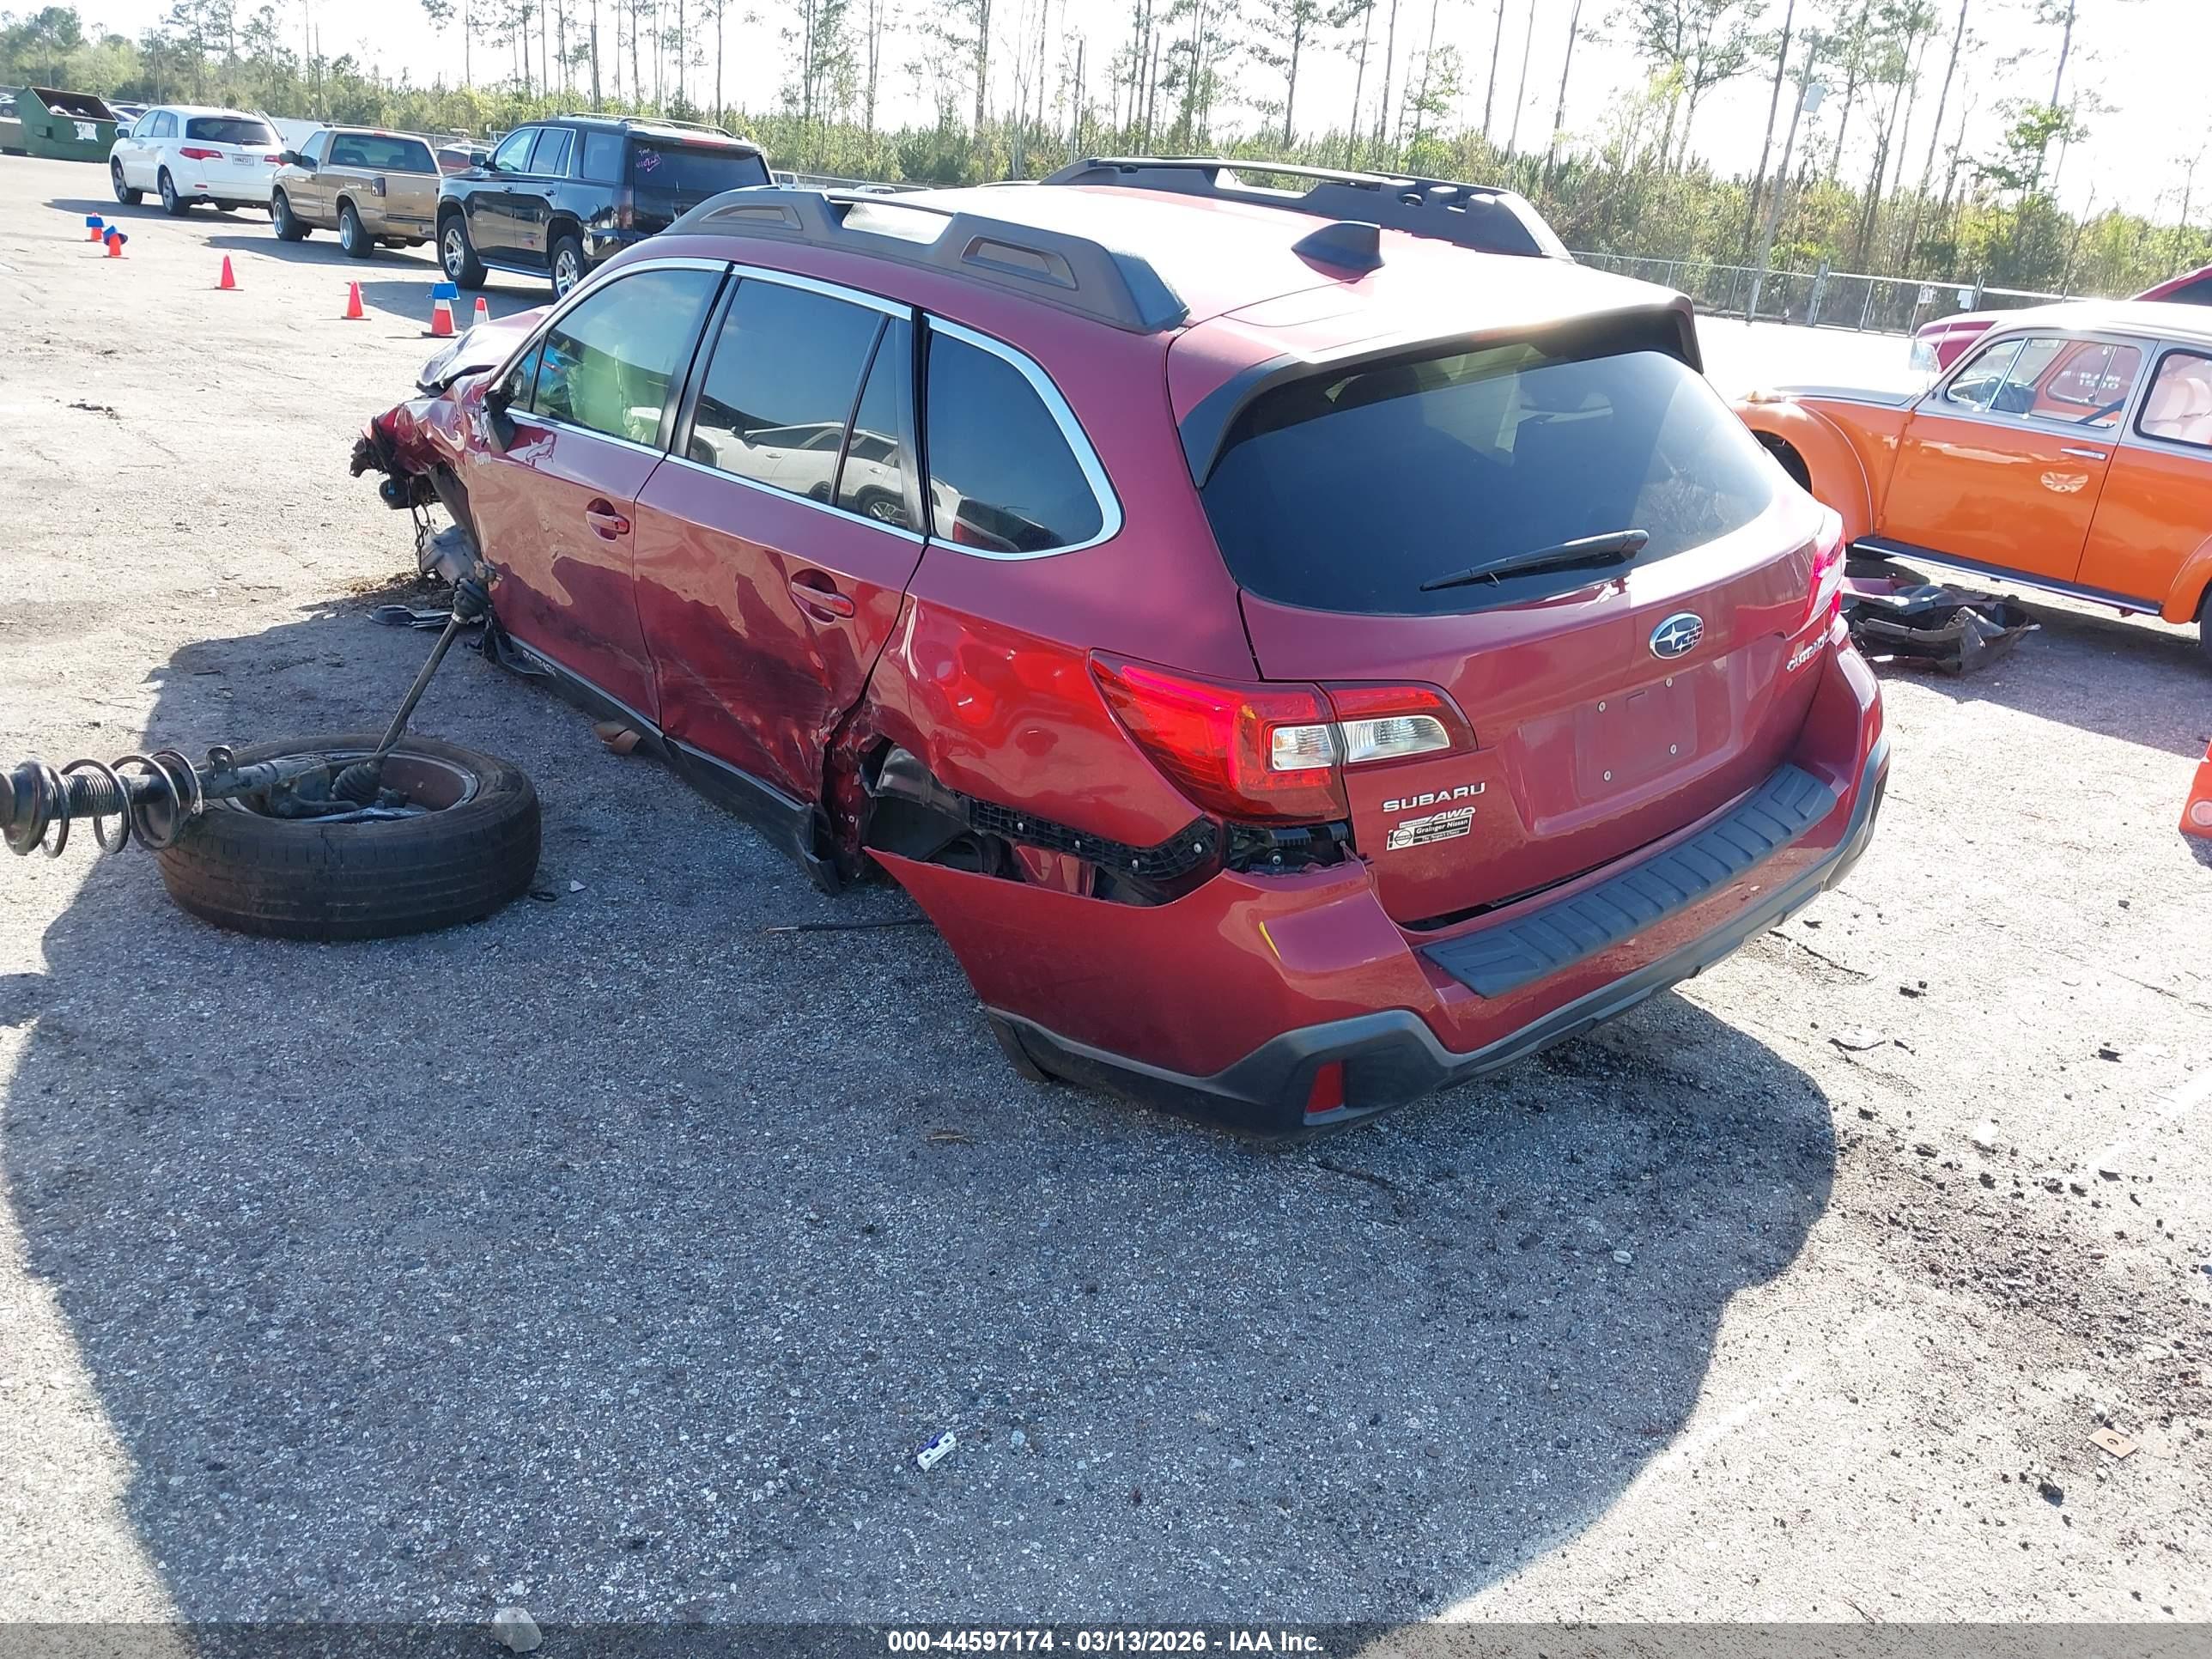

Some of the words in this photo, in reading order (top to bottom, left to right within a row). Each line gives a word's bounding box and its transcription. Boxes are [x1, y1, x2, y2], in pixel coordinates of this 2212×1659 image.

[1382, 782, 1486, 812] SUBARU
[1429, 806, 1476, 822] AWD
[1416, 823, 1446, 835] Grainger
[1447, 819, 1468, 829] Nissan
